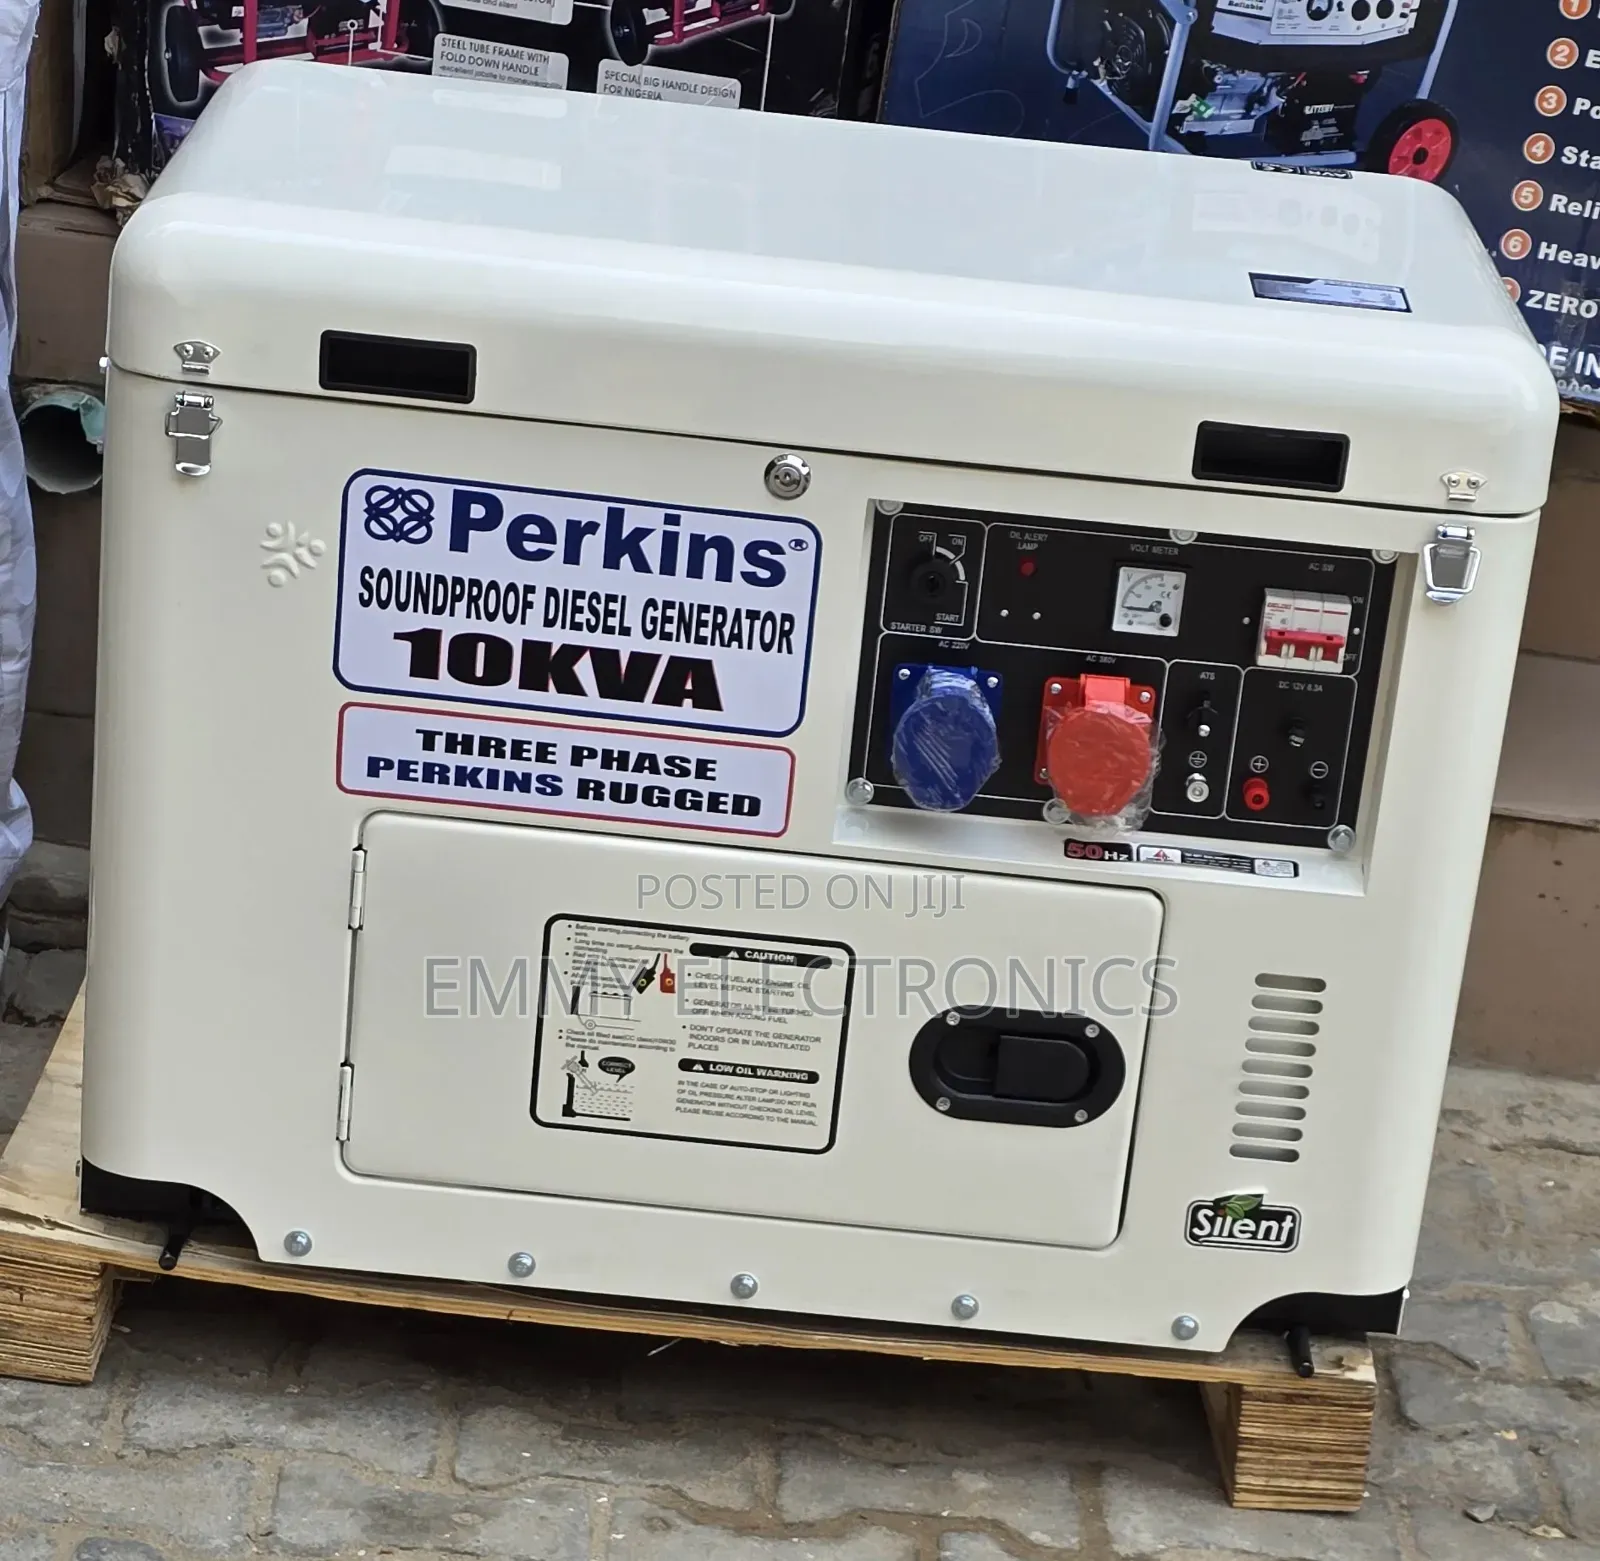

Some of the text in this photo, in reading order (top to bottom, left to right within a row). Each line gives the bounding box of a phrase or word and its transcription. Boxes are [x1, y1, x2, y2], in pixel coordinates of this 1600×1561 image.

[441, 37, 550, 65] STEEL TUBE FRAME WITH
[1553, 44, 1570, 62] 2
[440, 51, 541, 76] FOLD DOWN HANDLE
[603, 83, 622, 96] FOR
[604, 69, 737, 99] SPECIAL BIG HANDLE DESIGN
[1542, 92, 1558, 109] 3
[1532, 140, 1600, 170] 4 Sta
[1519, 186, 1600, 220] 5 Reli
[1507, 235, 1523, 253] 6
[1525, 289, 1598, 319] ZERO
[919, 534, 934, 542] OFF
[951, 537, 964, 546] ON
[1130, 543, 1179, 556] VOLT METER
[1308, 563, 1320, 571] AC
[1352, 595, 1365, 604] ON
[358, 565, 795, 655] SOUNDPROOF DIESEL GENERATOR
[935, 613, 960, 622] START
[890, 622, 927, 633] STARTER
[393, 627, 724, 712] 10KVA
[1200, 671, 1216, 681] ATS
[415, 729, 718, 781] THREE PHASE
[366, 756, 762, 818] PERKINS RUGGED
[576, 923, 596, 931] Before
[744, 950, 795, 963] CAUTION
[689, 1033, 726, 1043] INDOORS
[752, 1039, 811, 1052] UNVENTILATED
[716, 1027, 753, 1037] OPERATE
[755, 1030, 771, 1039] THE
[772, 1032, 822, 1043] GENERATOR
[688, 1042, 720, 1052] PLACES
[709, 1063, 809, 1080] LOW OIL WARNING
[1192, 1207, 1295, 1241] Silent
